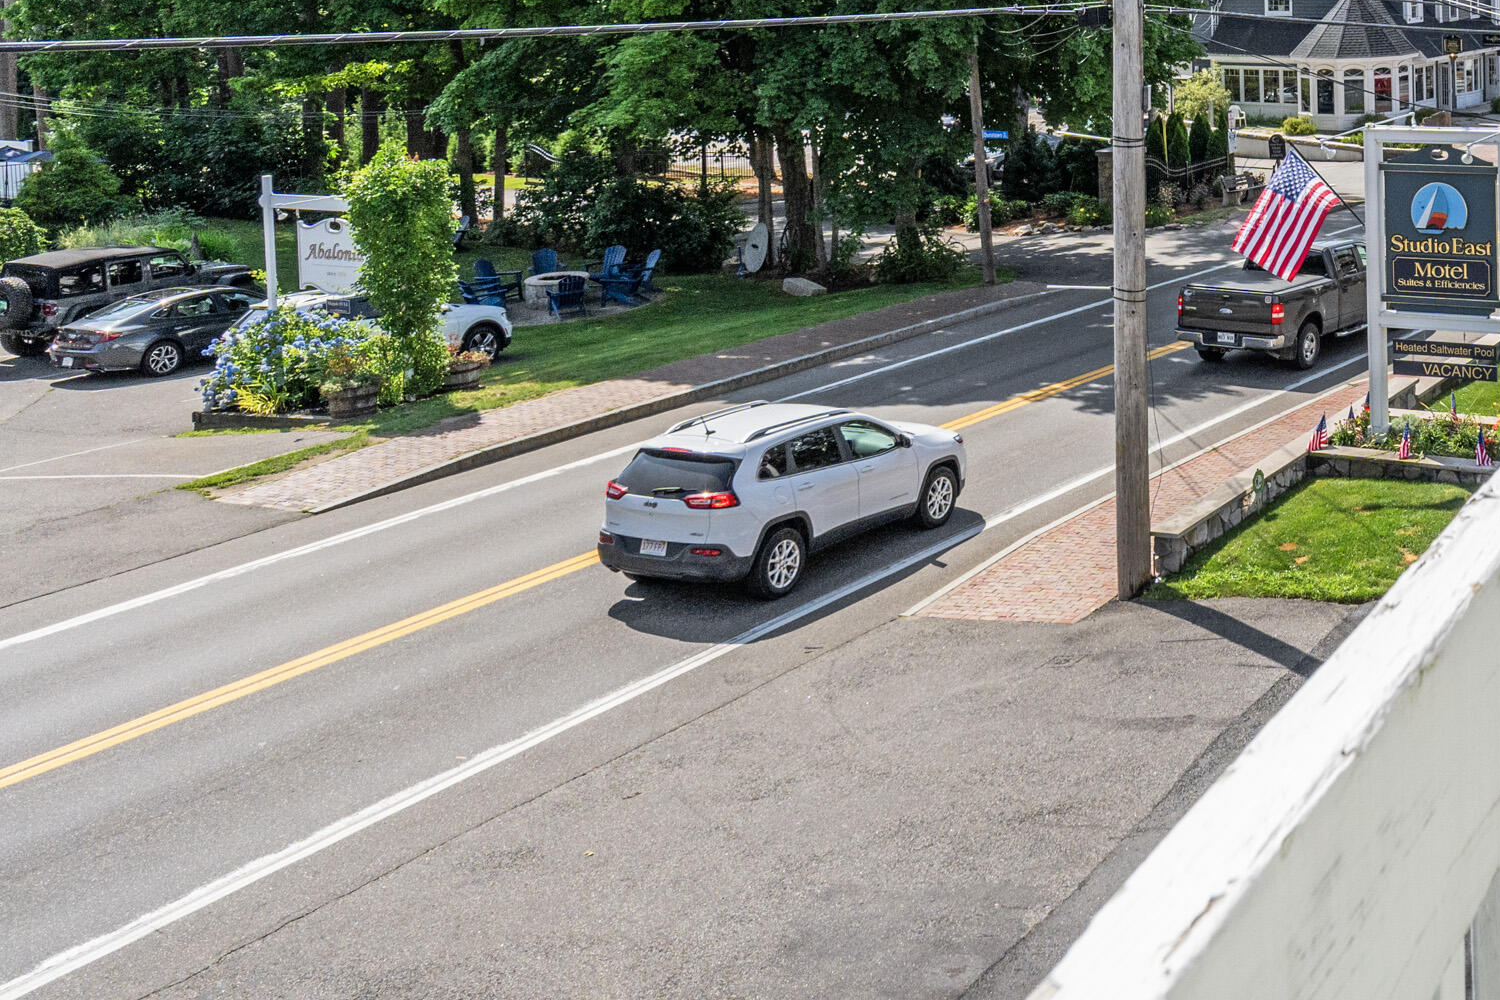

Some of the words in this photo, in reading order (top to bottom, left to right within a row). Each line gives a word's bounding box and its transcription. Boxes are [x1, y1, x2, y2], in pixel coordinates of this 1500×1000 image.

[1390, 234, 1450, 254] Studio
[1451, 237, 1492, 256] East
[1414, 261, 1468, 280] Motel
[1397, 278, 1424, 287] Suites
[1425, 279, 1433, 288] &
[1435, 280, 1485, 290] Efficiencies
[1395, 341, 1428, 353] Heated
[1430, 344, 1471, 356] Saltwater
[1474, 347, 1495, 357] Pool
[1422, 363, 1492, 380] VACANCY
